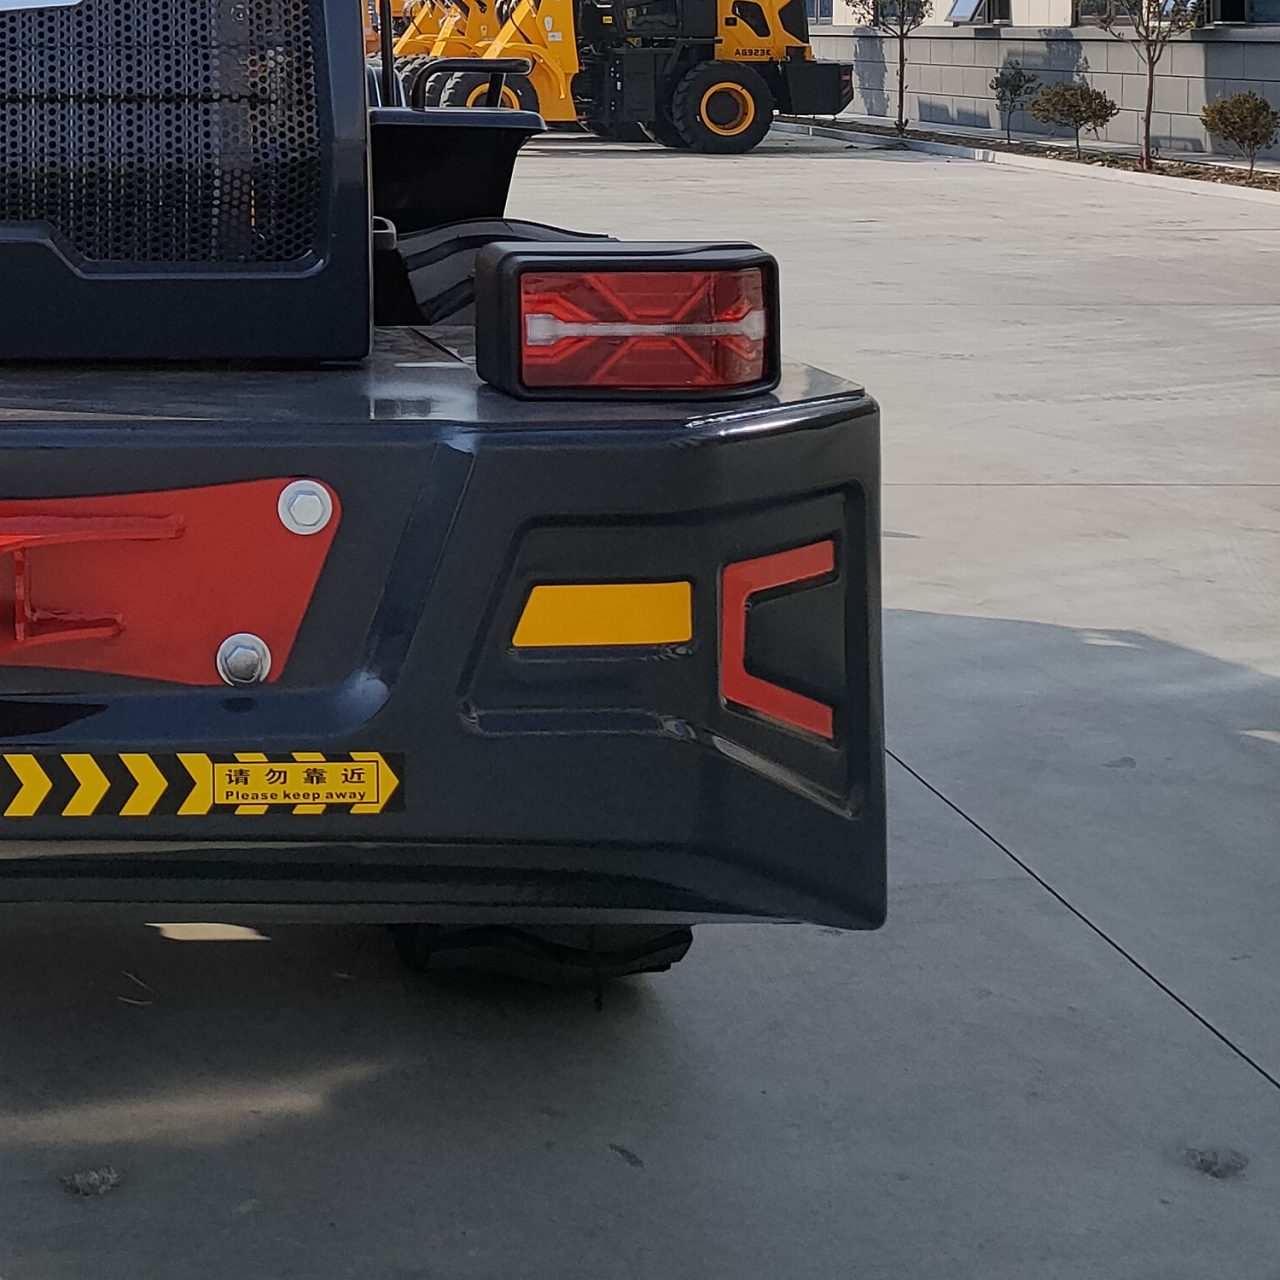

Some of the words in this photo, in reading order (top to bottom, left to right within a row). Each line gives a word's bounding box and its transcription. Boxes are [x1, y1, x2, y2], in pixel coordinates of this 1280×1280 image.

[225, 767, 367, 786] 请勿靠近
[225, 789, 279, 801] Please
[283, 789, 321, 803] keep
[325, 790, 367, 802] away
